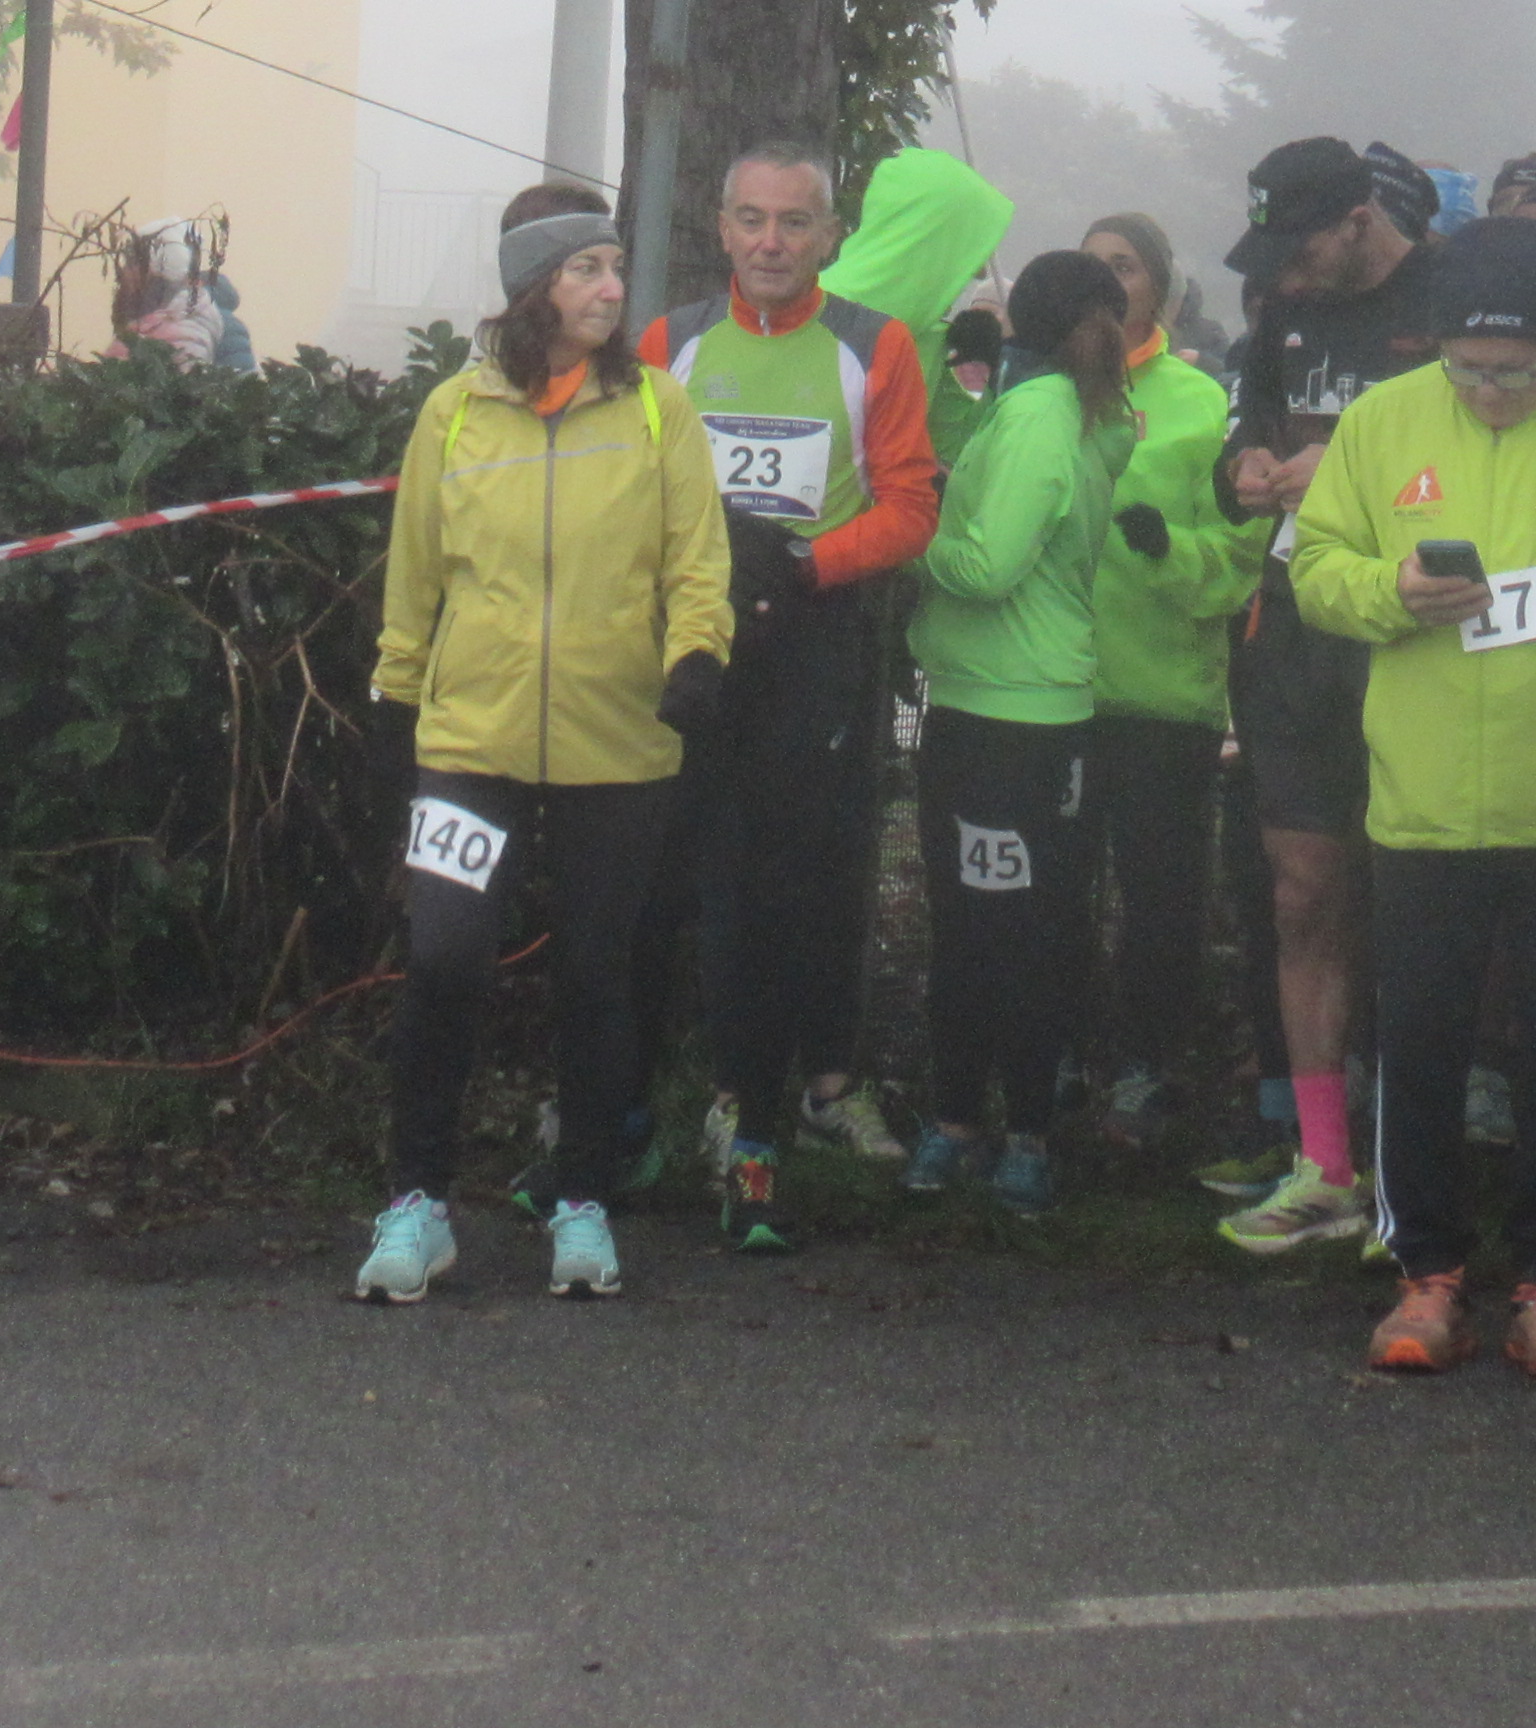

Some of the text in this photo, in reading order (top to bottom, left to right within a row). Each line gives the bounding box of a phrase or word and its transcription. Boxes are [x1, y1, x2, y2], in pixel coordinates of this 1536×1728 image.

[727, 445, 782, 488] 23
[412, 810, 492, 871] 140
[967, 838, 1023, 880] 45
